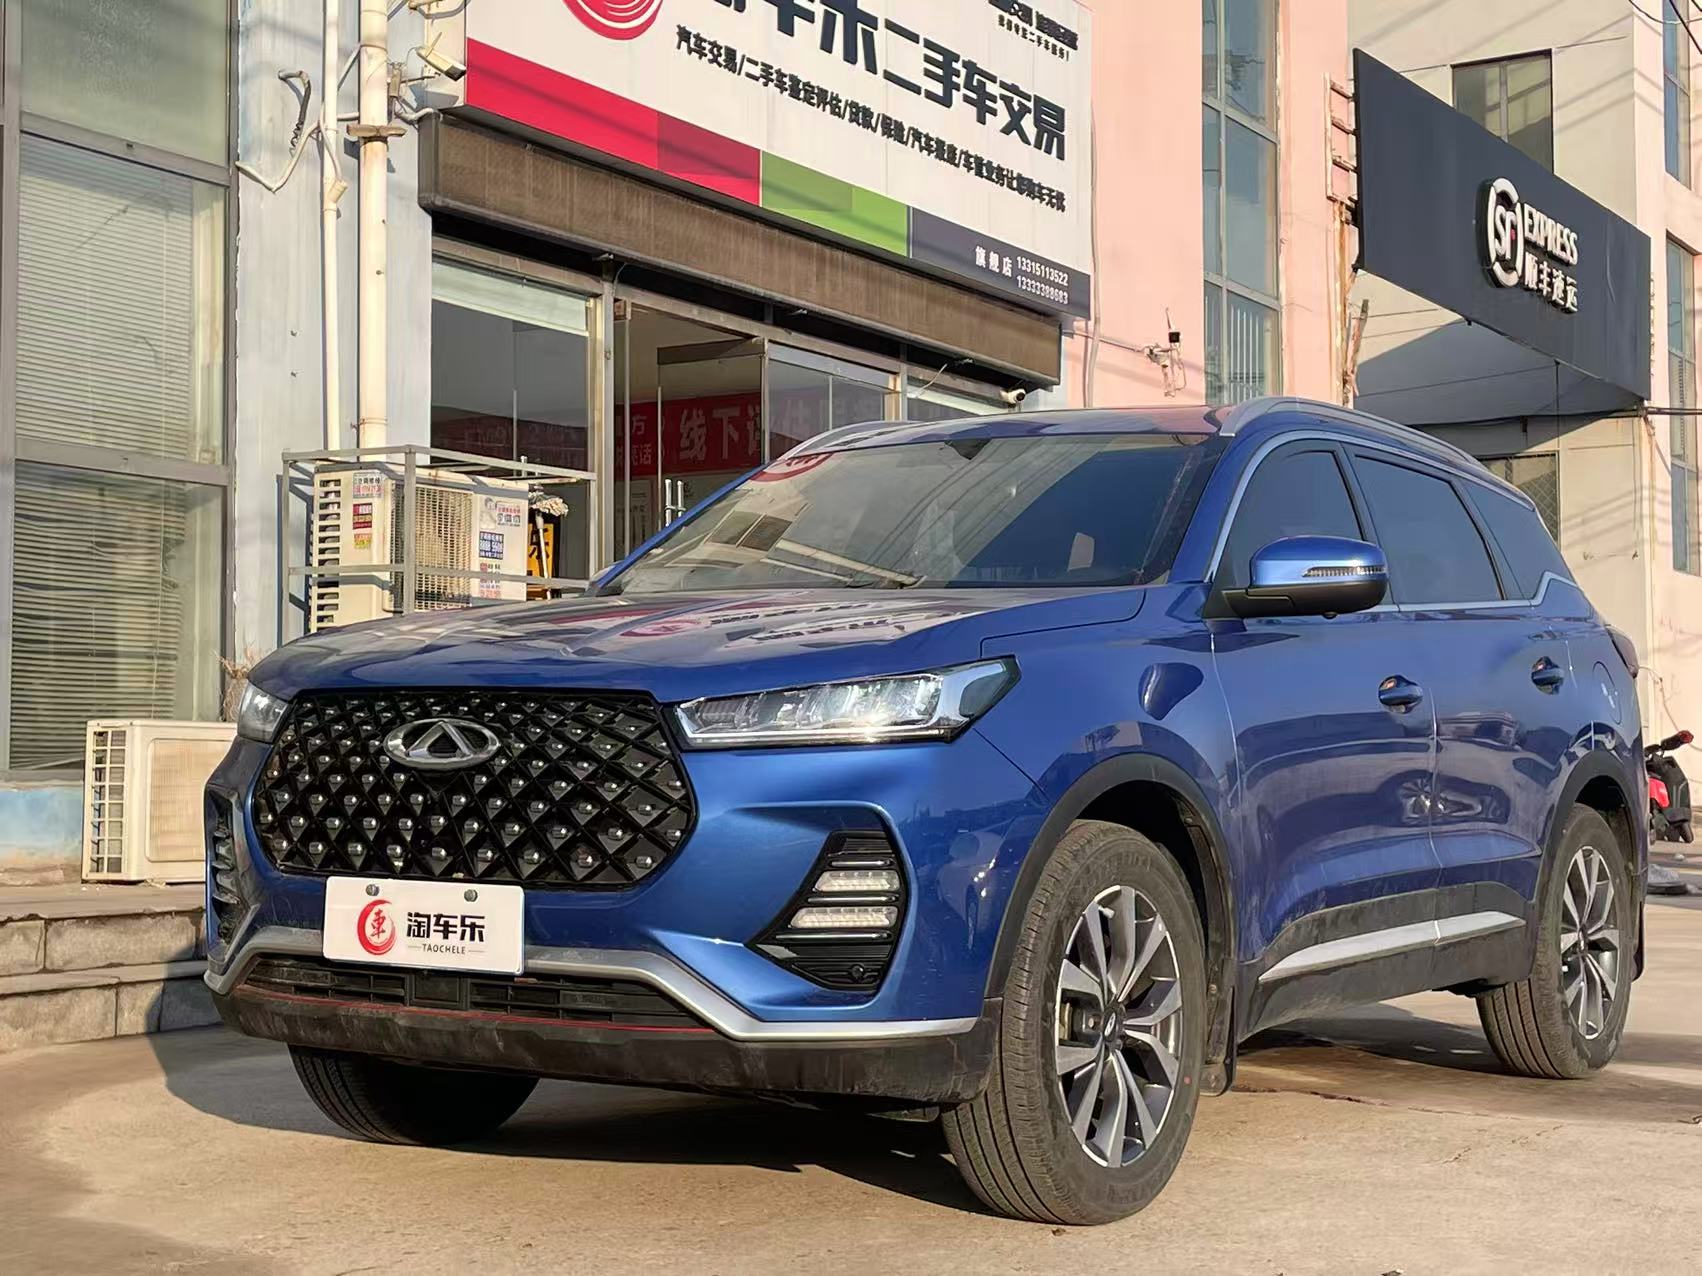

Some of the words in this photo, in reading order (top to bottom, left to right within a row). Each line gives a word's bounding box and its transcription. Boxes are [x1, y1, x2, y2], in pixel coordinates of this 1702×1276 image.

[1524, 203, 1578, 265] EXPRESS
[975, 245, 1013, 277] 旗舰店
[1017, 256, 1069, 287] 13315113522
[1525, 252, 1578, 312] 顺丰速运
[406, 911, 486, 943] 淘车乐
[422, 943, 466, 955] TAOCHELE
